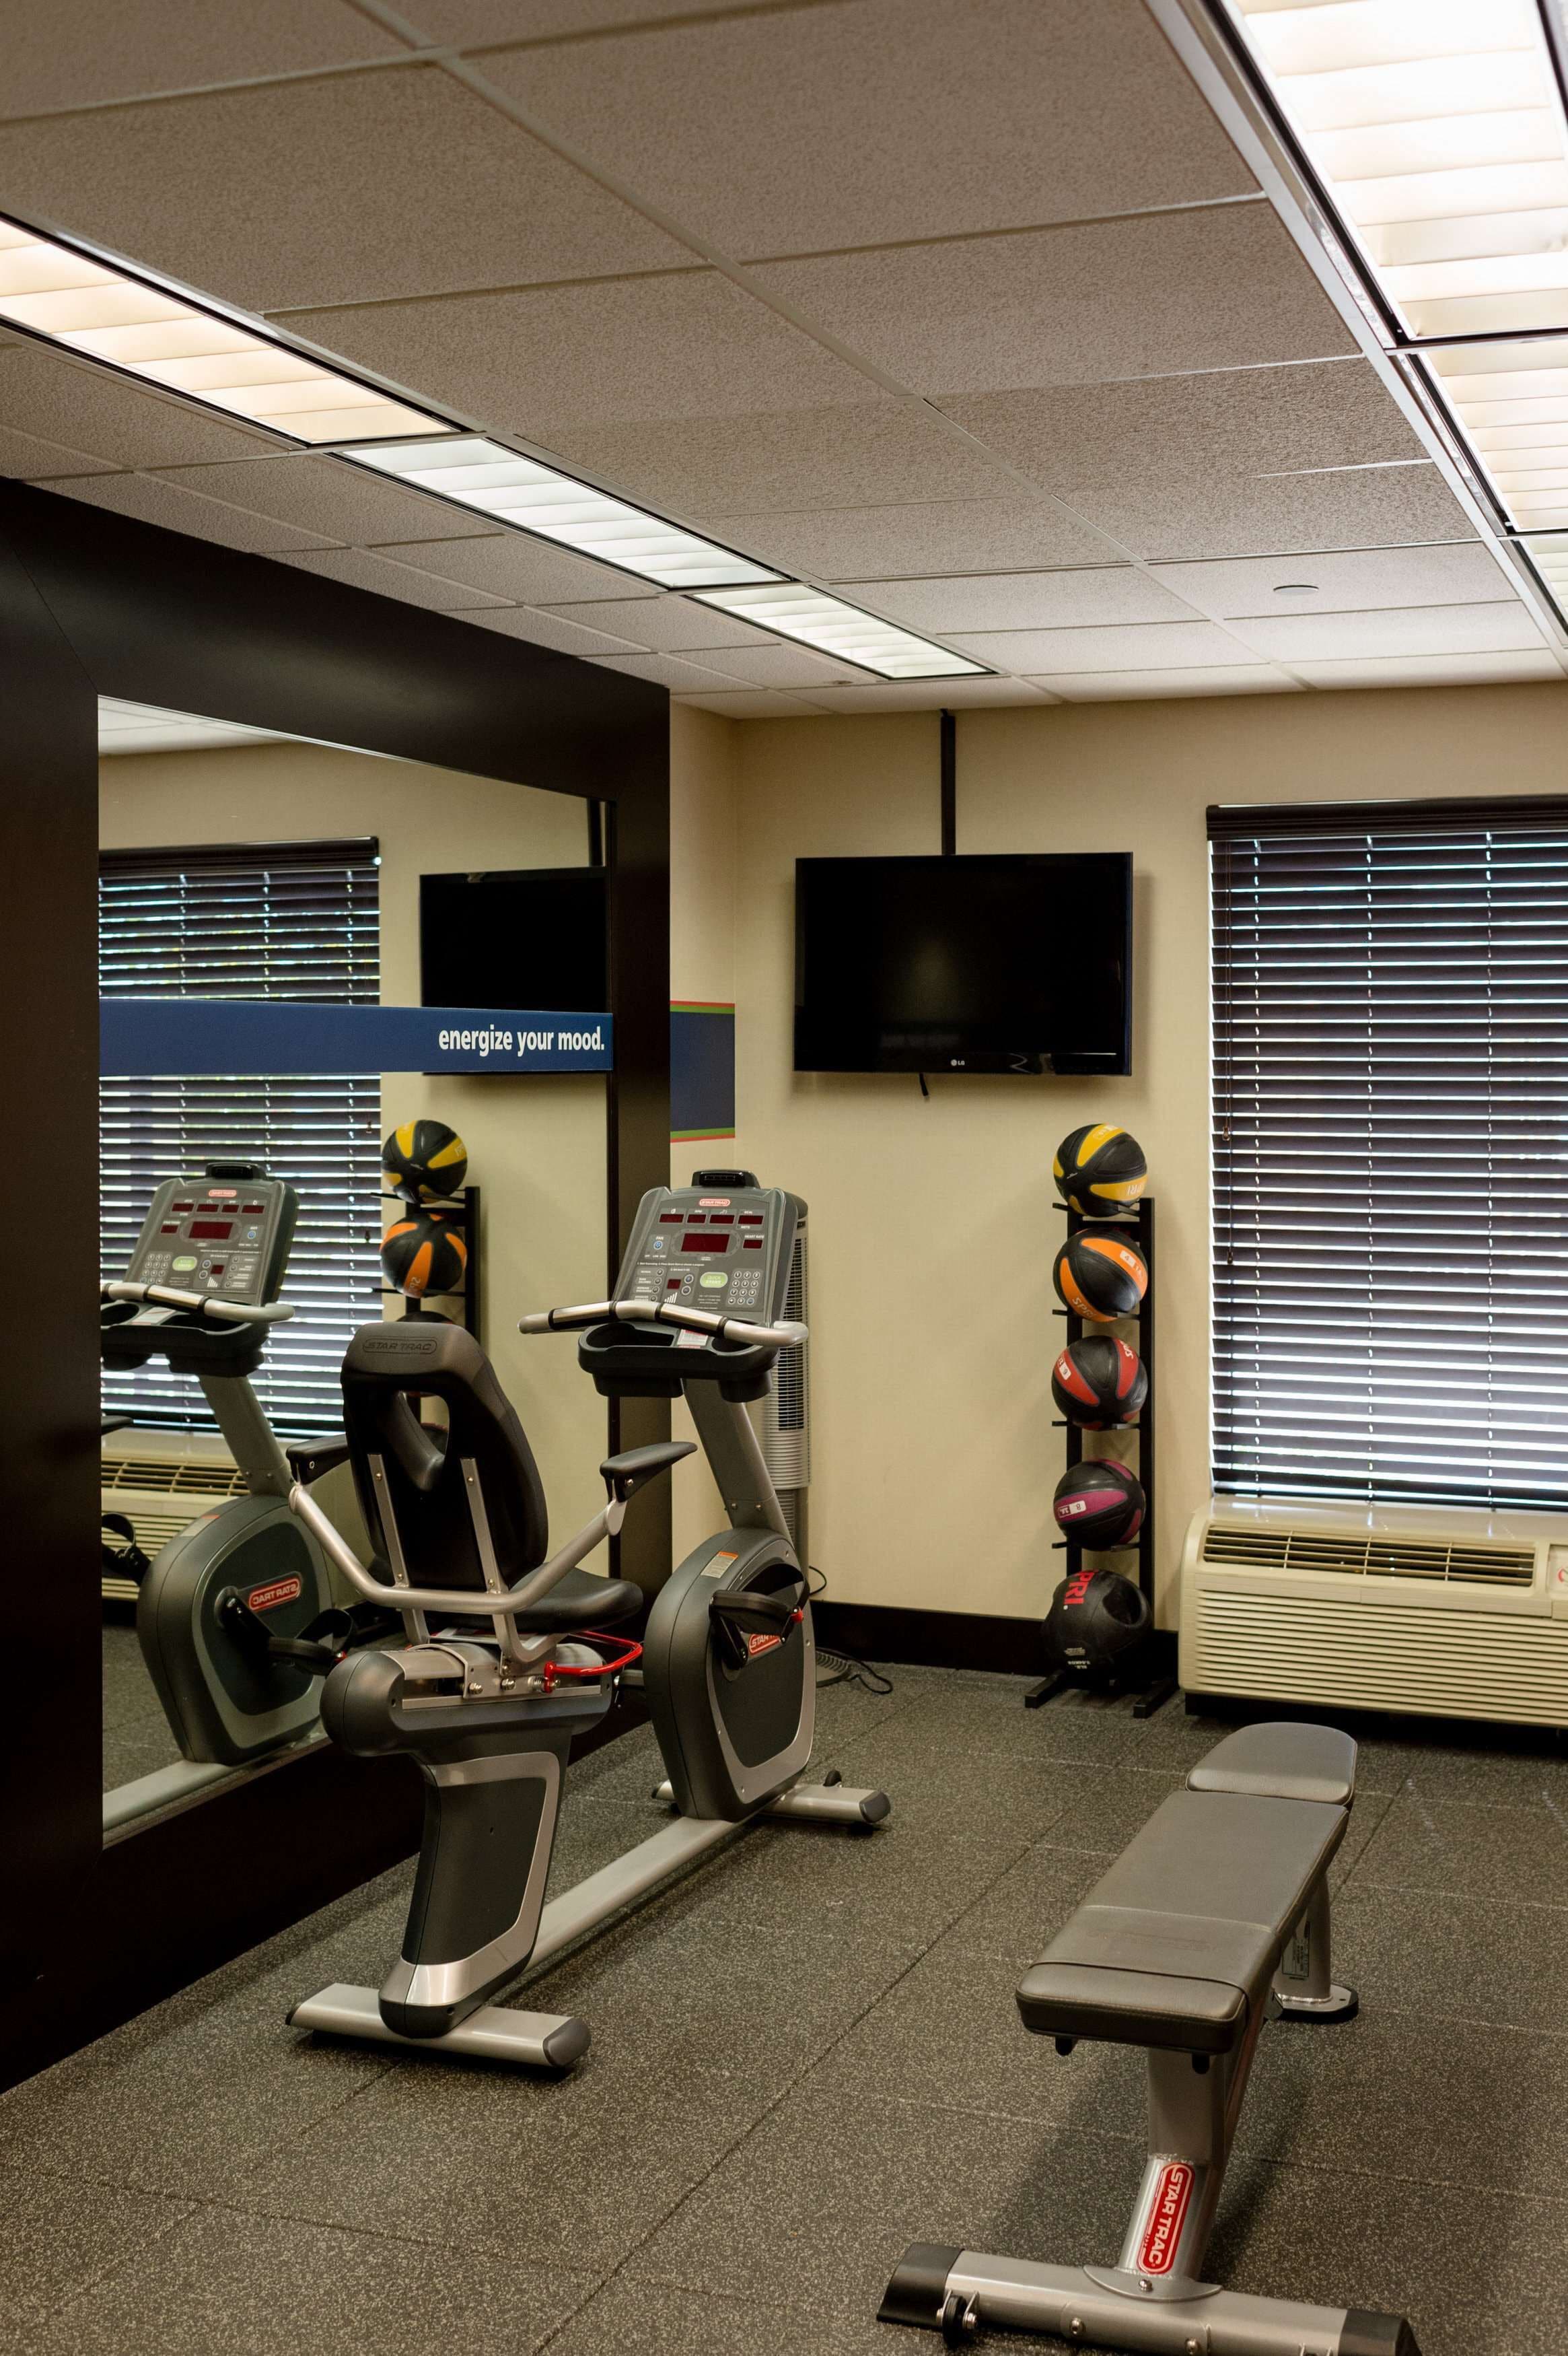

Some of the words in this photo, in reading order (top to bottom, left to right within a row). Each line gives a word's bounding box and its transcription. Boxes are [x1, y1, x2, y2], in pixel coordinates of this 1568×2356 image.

[439, 1024, 513, 1057] energize
[517, 1031, 554, 1057] your
[558, 1026, 604, 1051] mood.
[365, 1342, 398, 1350] STAR
[400, 1343, 431, 1352] TRAC
[1063, 1572, 1094, 1605] PRI
[1162, 2172, 1184, 2215] STAR
[1149, 2217, 1172, 2264] TRAC
